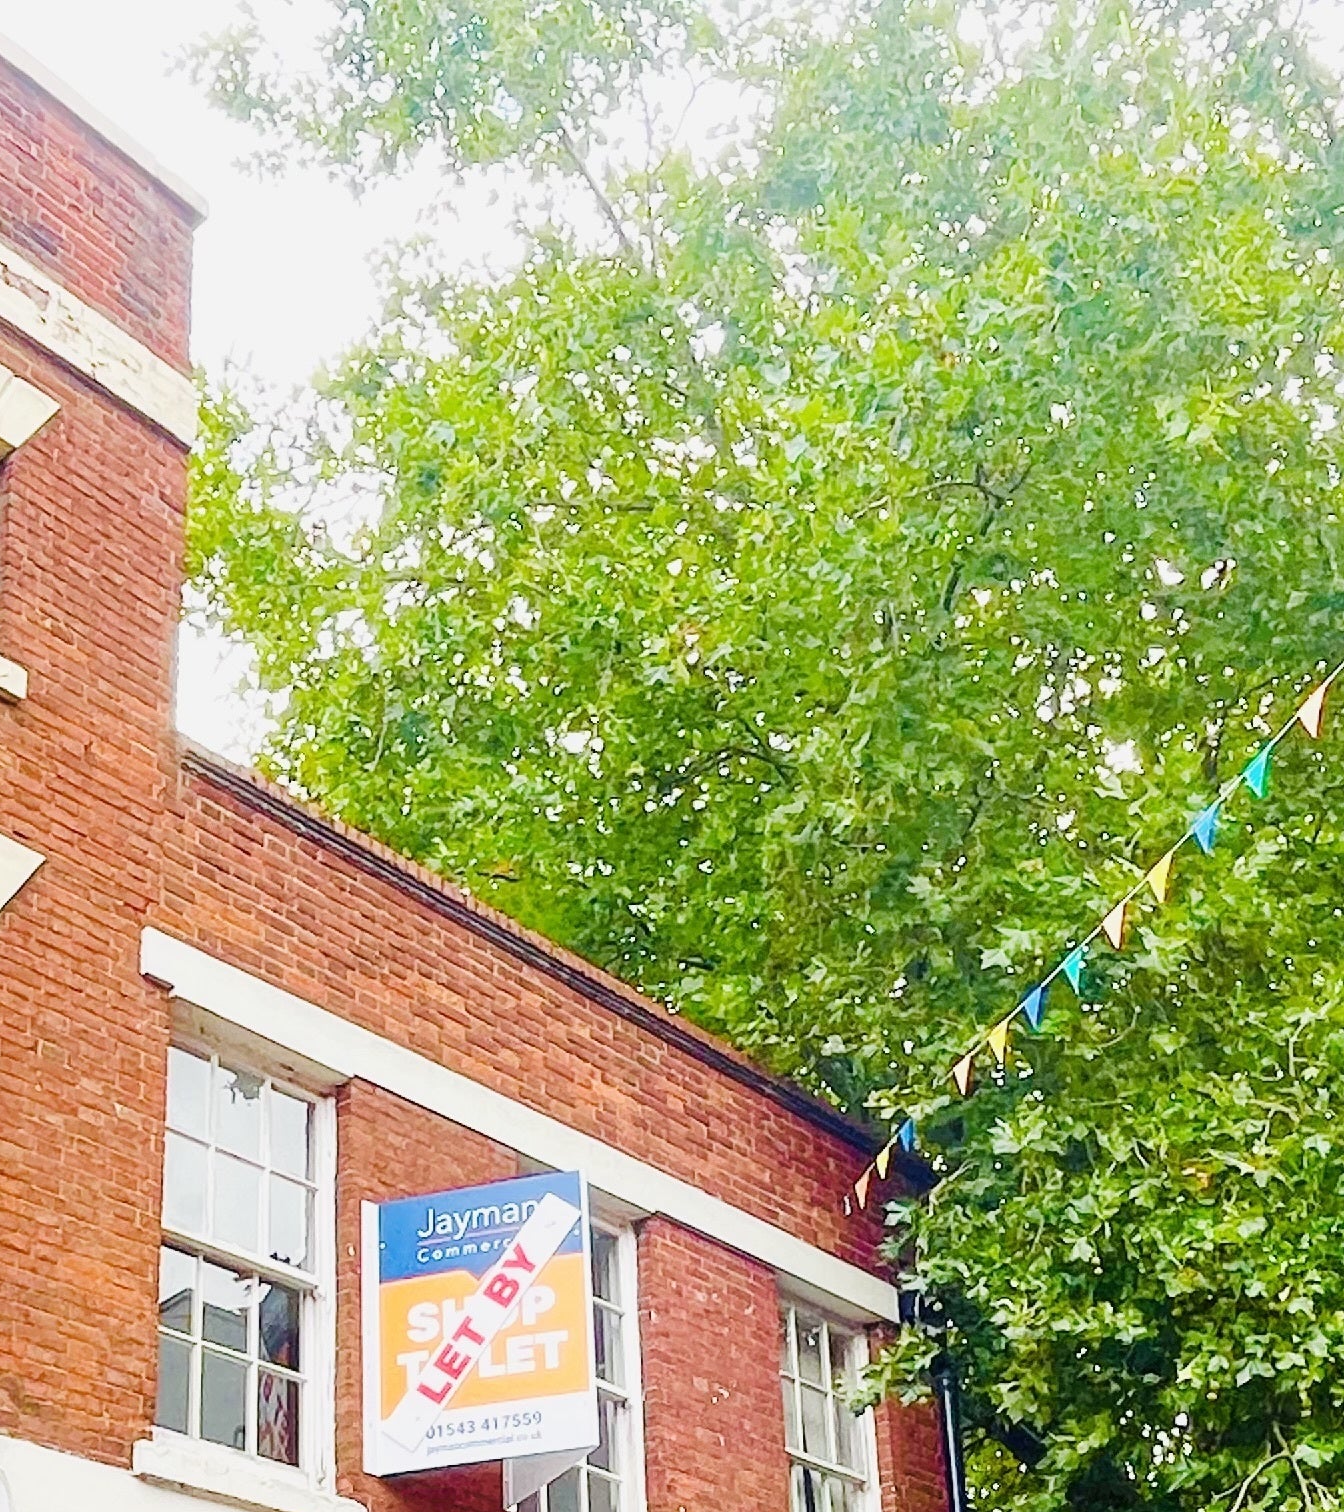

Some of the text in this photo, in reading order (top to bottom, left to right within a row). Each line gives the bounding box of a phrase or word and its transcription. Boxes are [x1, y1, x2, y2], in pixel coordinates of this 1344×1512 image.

[417, 1200, 540, 1241] Jayman
[416, 1238, 512, 1264] Commerc
[406, 1284, 556, 1344] SHP
[417, 1315, 486, 1405] LET
[482, 1243, 537, 1309] BY
[425, 1410, 543, 1440] 01543 417559
